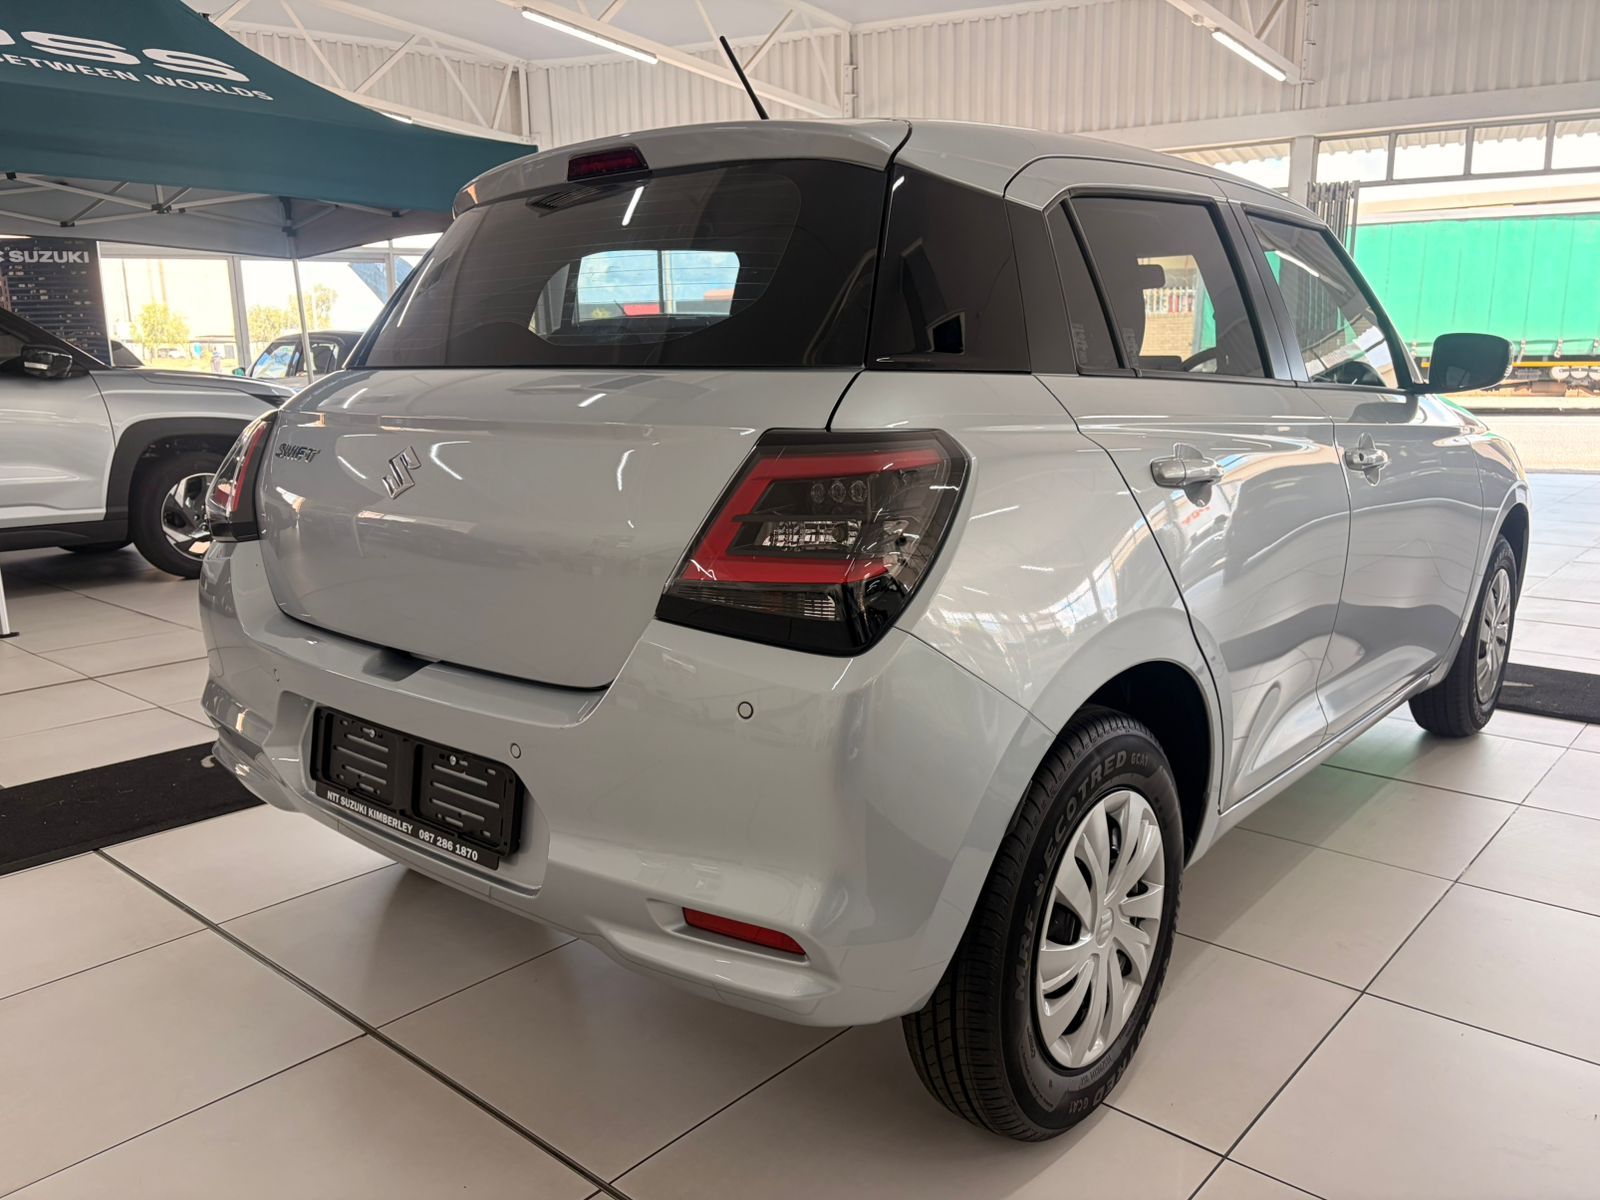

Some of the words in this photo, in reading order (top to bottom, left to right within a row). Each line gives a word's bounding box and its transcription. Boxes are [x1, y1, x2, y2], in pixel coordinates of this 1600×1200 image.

[0, 28, 250, 82] SS
[0, 53, 140, 82] ETWEEN
[145, 74, 274, 101] WORLDS
[9, 250, 89, 263] SUZUKI
[275, 443, 321, 463] SWIFT
[327, 790, 340, 803] NTT
[340, 797, 367, 815] SUZUKI
[368, 808, 414, 835] KIMBERLEY
[418, 829, 435, 843] 087
[436, 836, 454, 851] 286
[455, 844, 479, 861] 1870
[1043, 750, 1127, 869] ECOTRED
